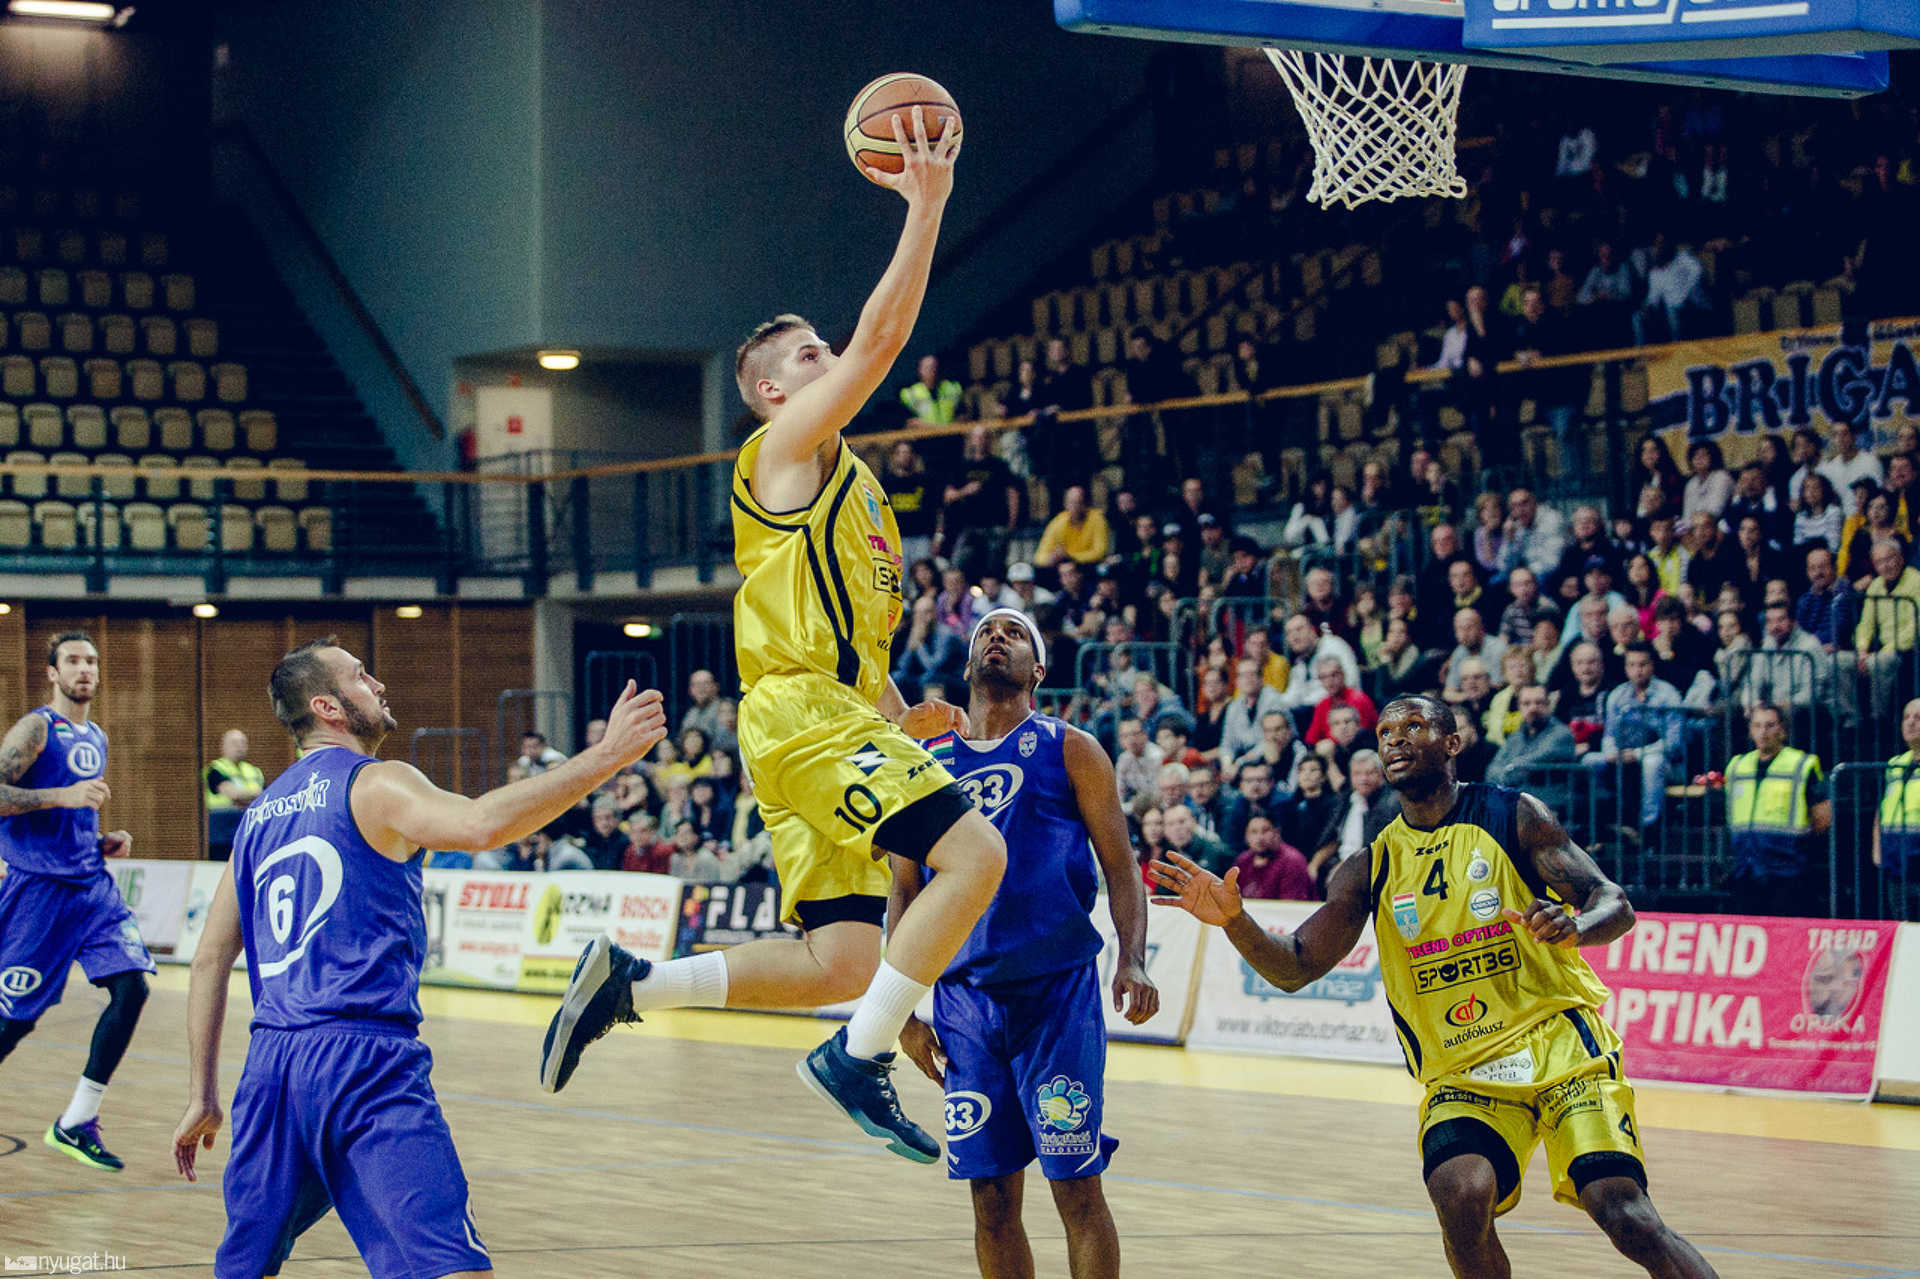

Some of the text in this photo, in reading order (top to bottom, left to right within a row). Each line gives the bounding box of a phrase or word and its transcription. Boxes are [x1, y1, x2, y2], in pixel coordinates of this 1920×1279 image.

[834, 784, 882, 834] 10
[962, 774, 1005, 813] 33
[1422, 858, 1449, 900] 4
[268, 874, 296, 945] 6
[1452, 920, 1513, 947] OPTIKA
[1807, 928, 1879, 951] TREND
[945, 1101, 975, 1131] 33
[1617, 1112, 1638, 1147] 4
